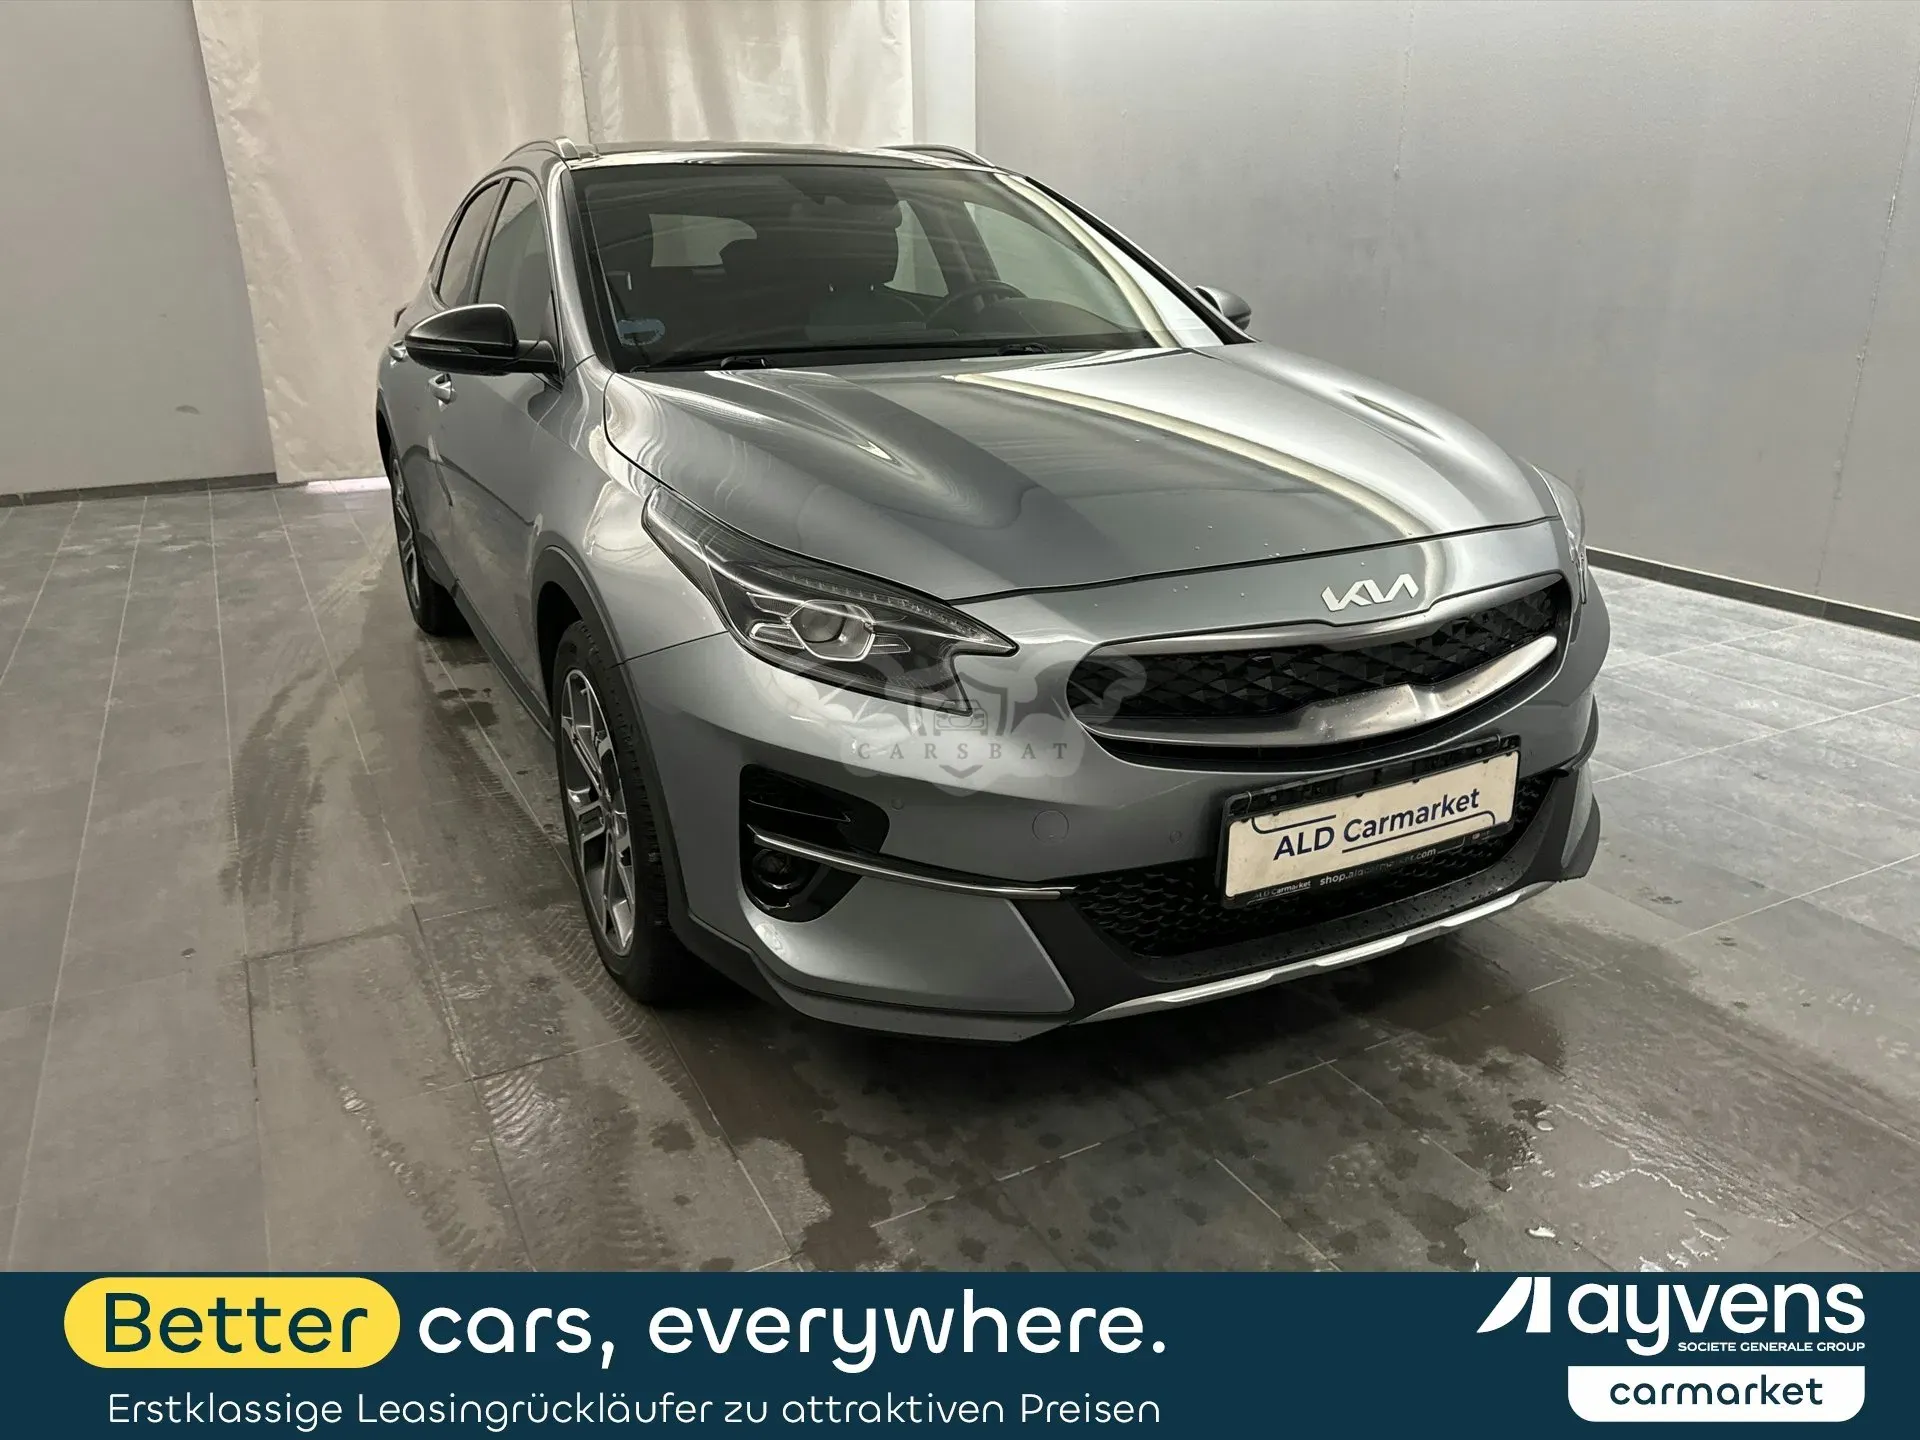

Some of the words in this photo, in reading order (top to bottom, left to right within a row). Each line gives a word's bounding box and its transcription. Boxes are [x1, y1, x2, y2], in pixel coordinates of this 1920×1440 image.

[1321, 573, 1419, 612] KIA
[1273, 826, 1335, 861] ALD
[1343, 787, 1480, 843] Carmarket
[1271, 880, 1312, 896] Carmarket
